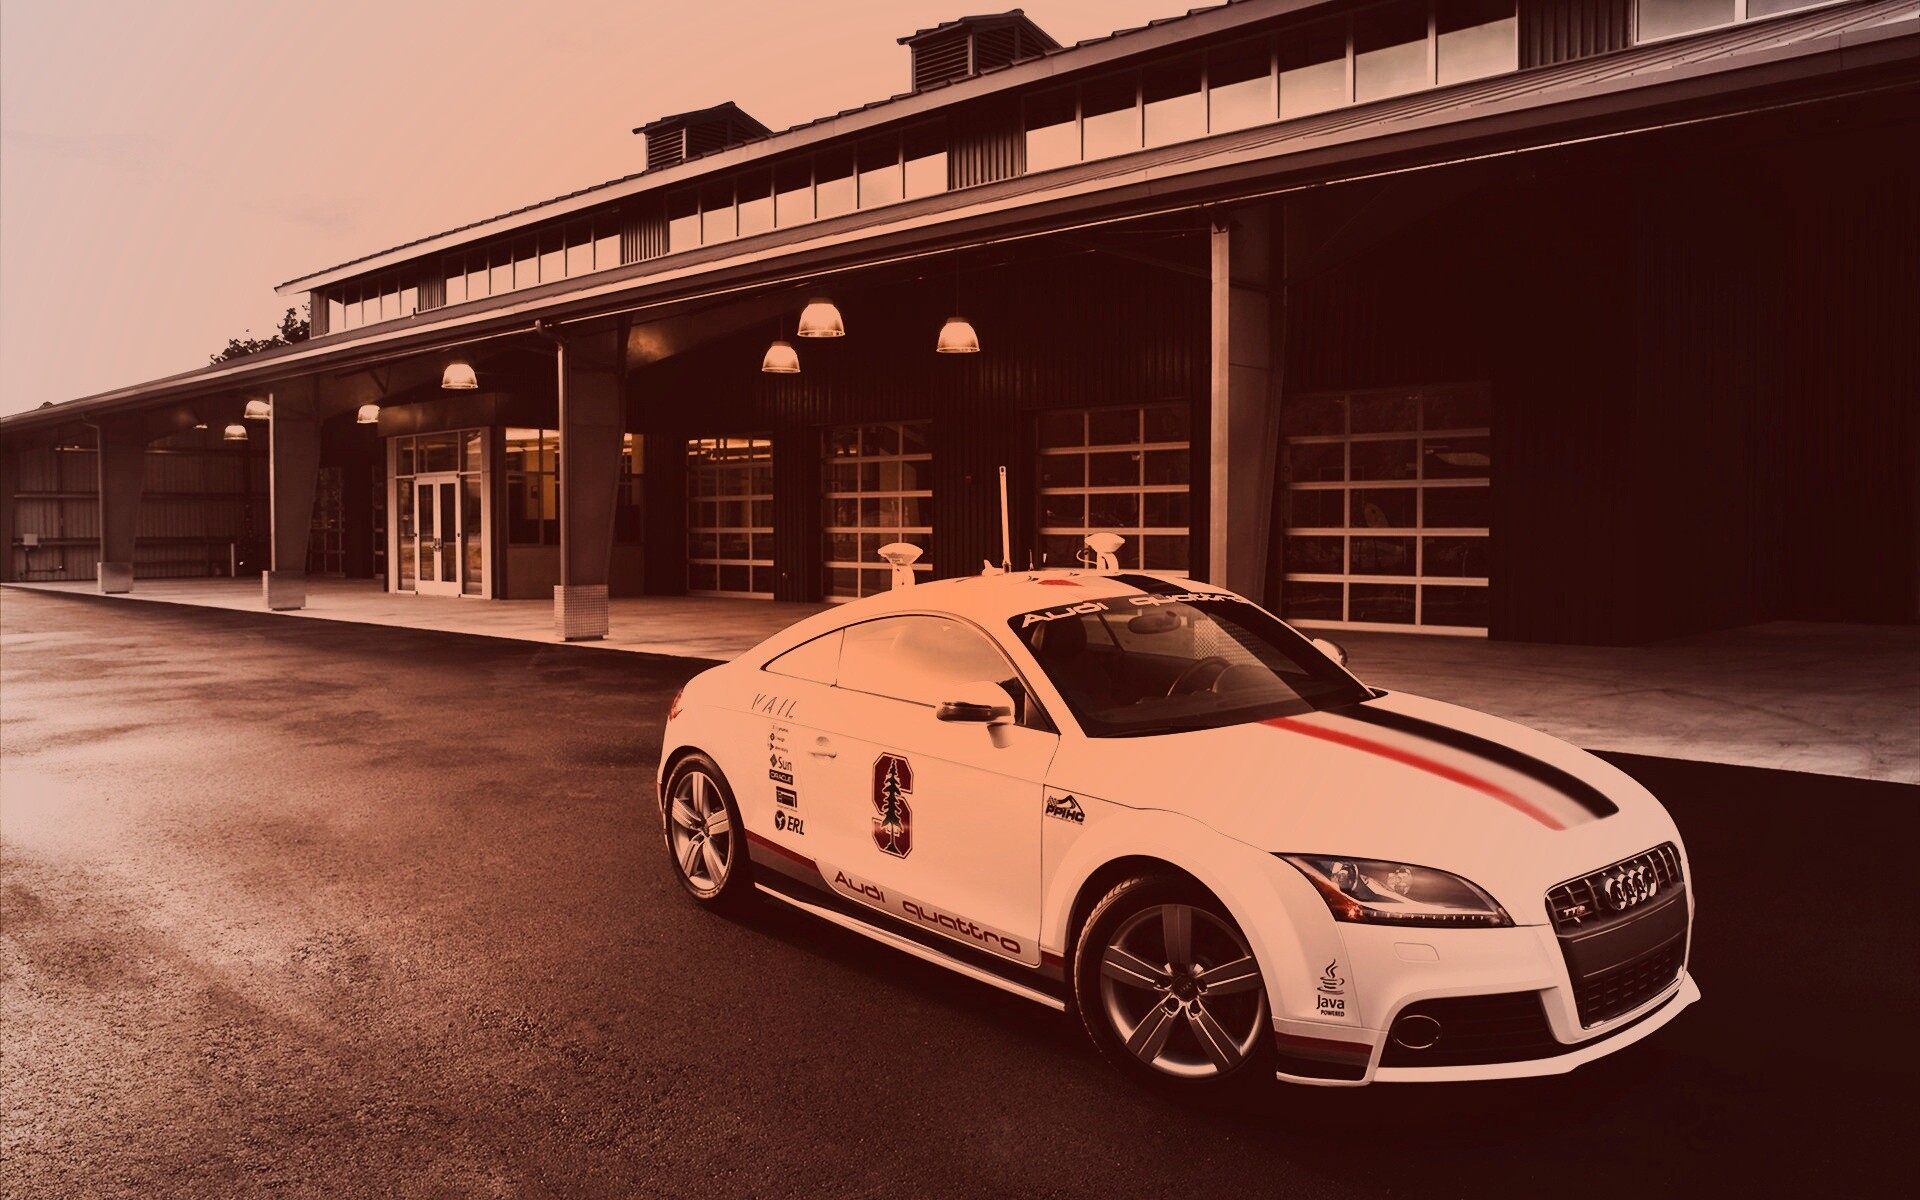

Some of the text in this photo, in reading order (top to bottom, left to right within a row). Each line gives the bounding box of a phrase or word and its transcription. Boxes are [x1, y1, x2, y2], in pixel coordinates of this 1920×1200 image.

[1022, 602, 1109, 628] Audi
[751, 693, 797, 718] VAIL
[778, 756, 793, 771] Sun
[770, 771, 792, 783] ORACLE
[1045, 804, 1085, 822] PPIHC
[787, 815, 805, 835] ERL
[834, 871, 1021, 954] Audi quattro
[1316, 995, 1345, 1010] Java
[1320, 1009, 1345, 1017] POWERED
